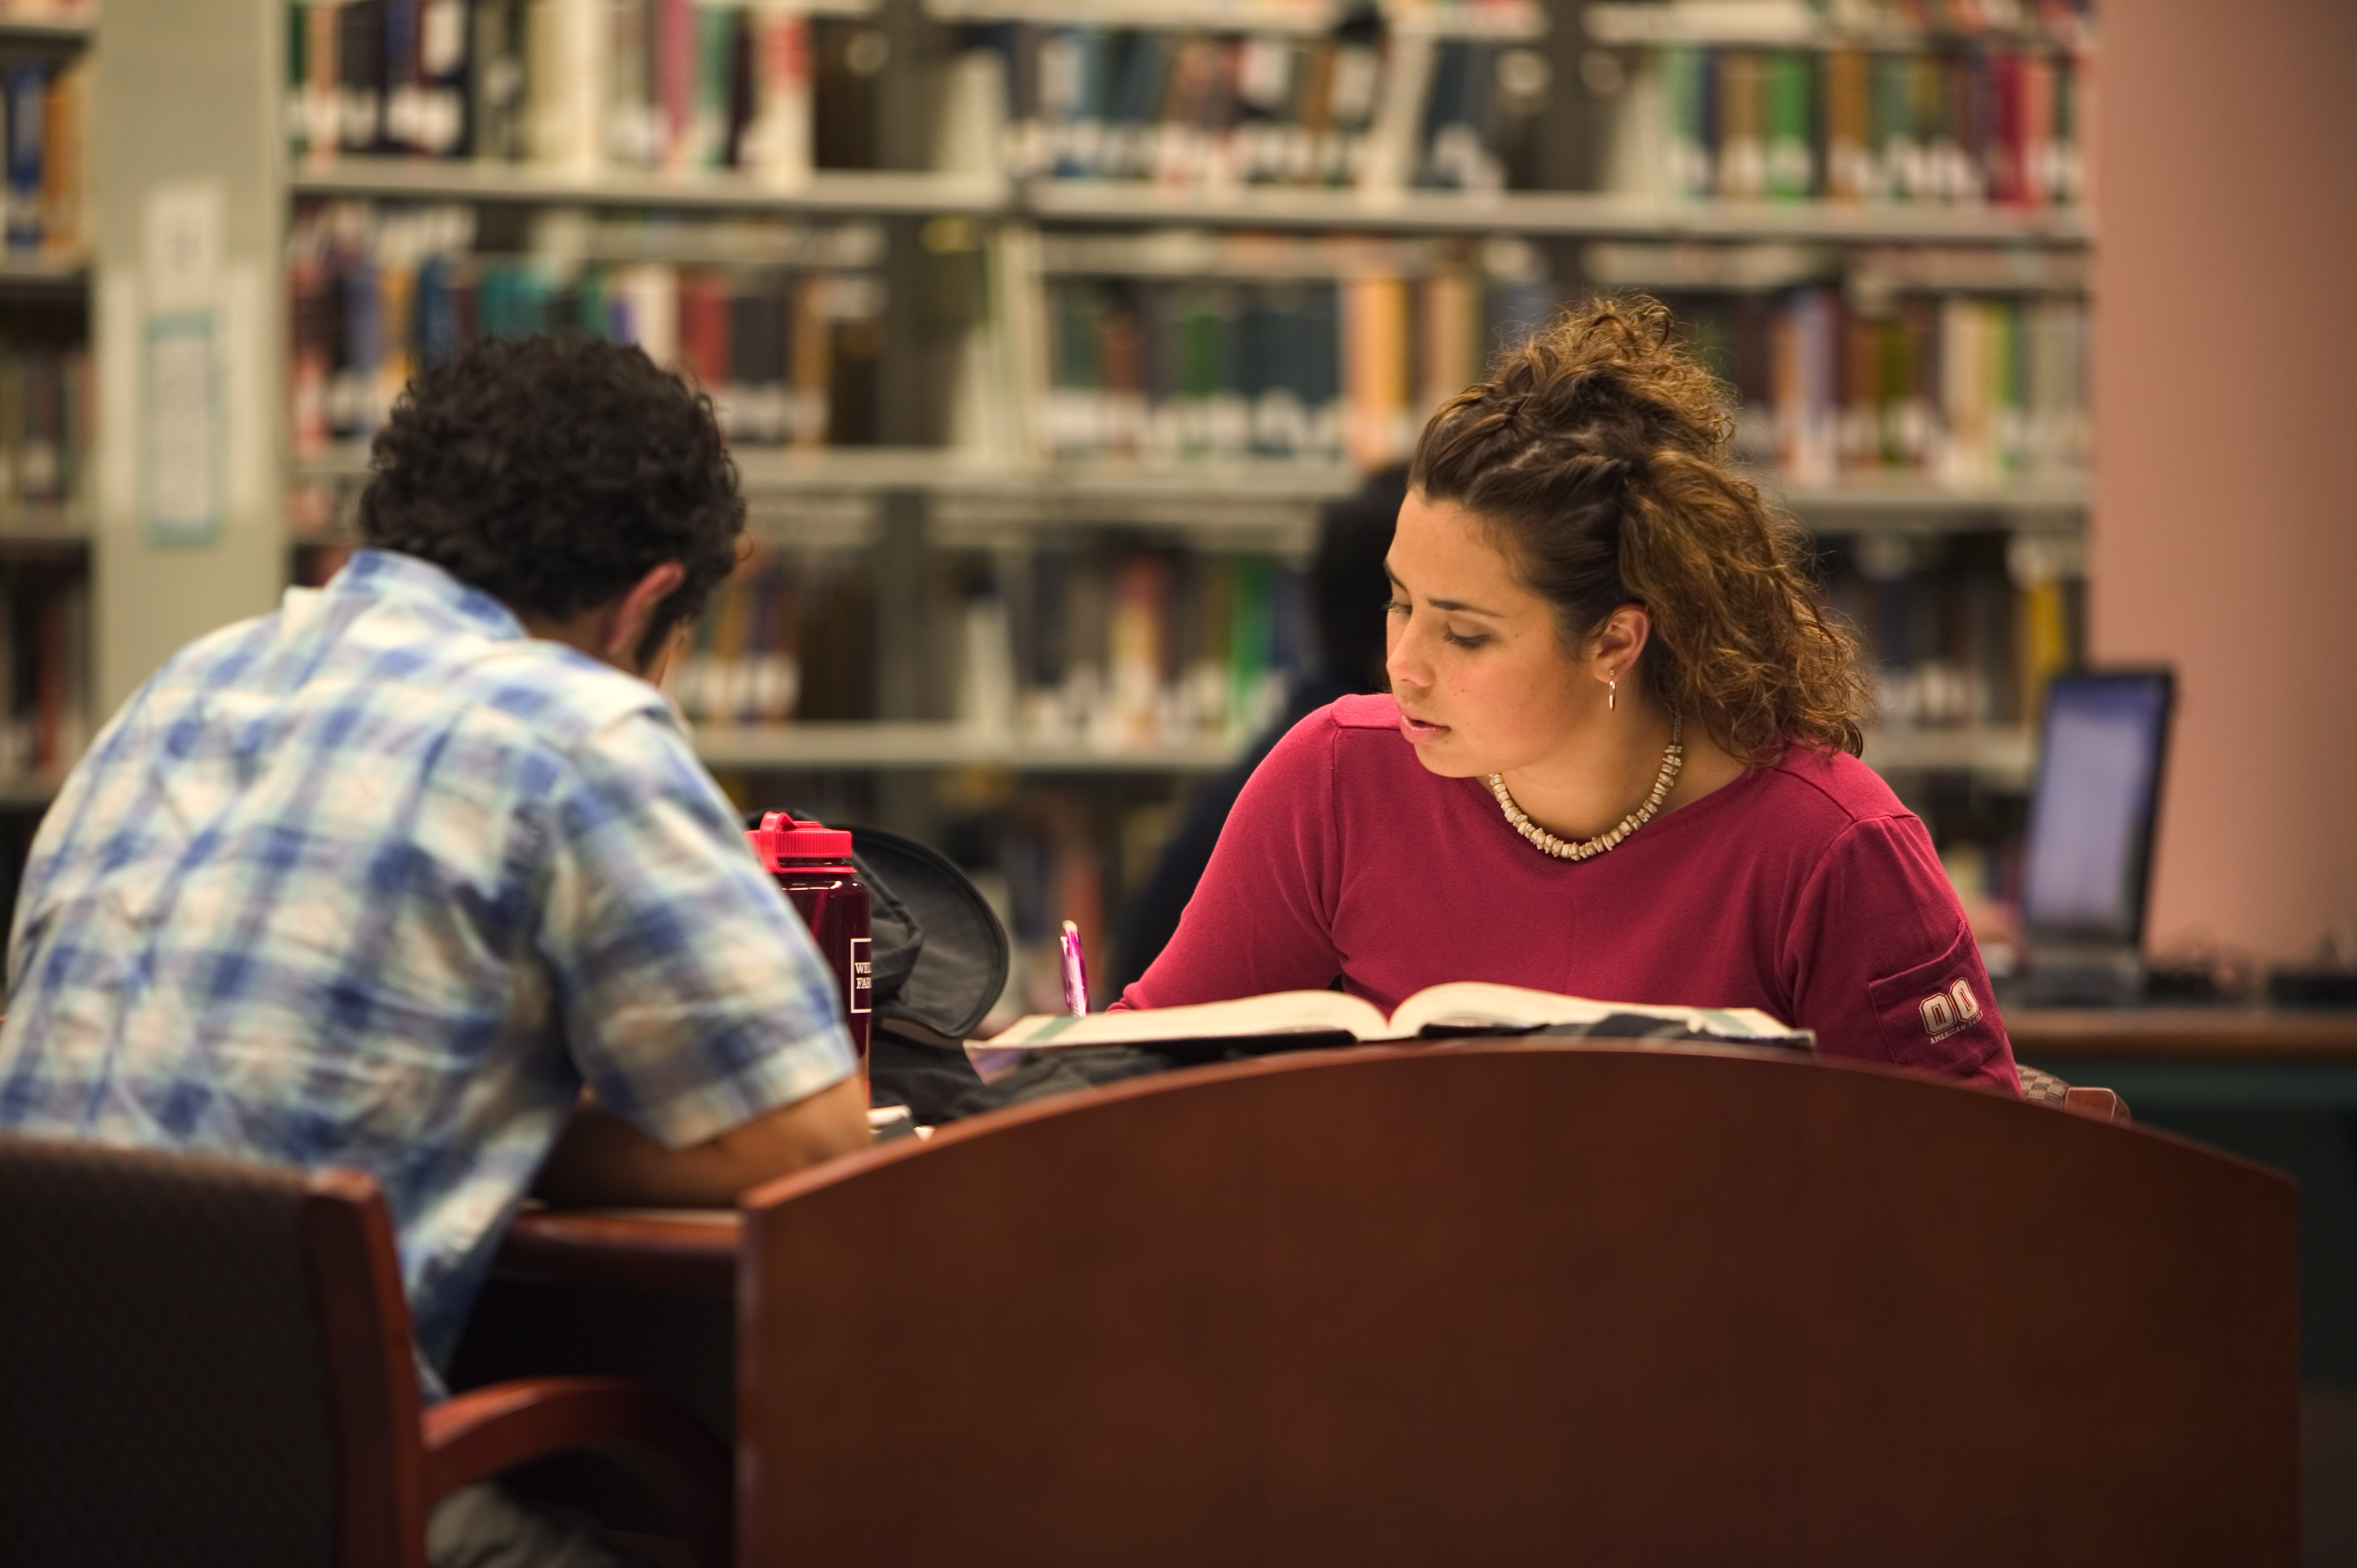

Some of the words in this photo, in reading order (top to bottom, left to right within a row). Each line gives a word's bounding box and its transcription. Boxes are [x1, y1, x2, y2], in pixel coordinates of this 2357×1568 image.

[854, 962, 872, 974] WEL
[856, 977, 872, 989] FAR
[1930, 1024, 1966, 1044] AMERICAN
